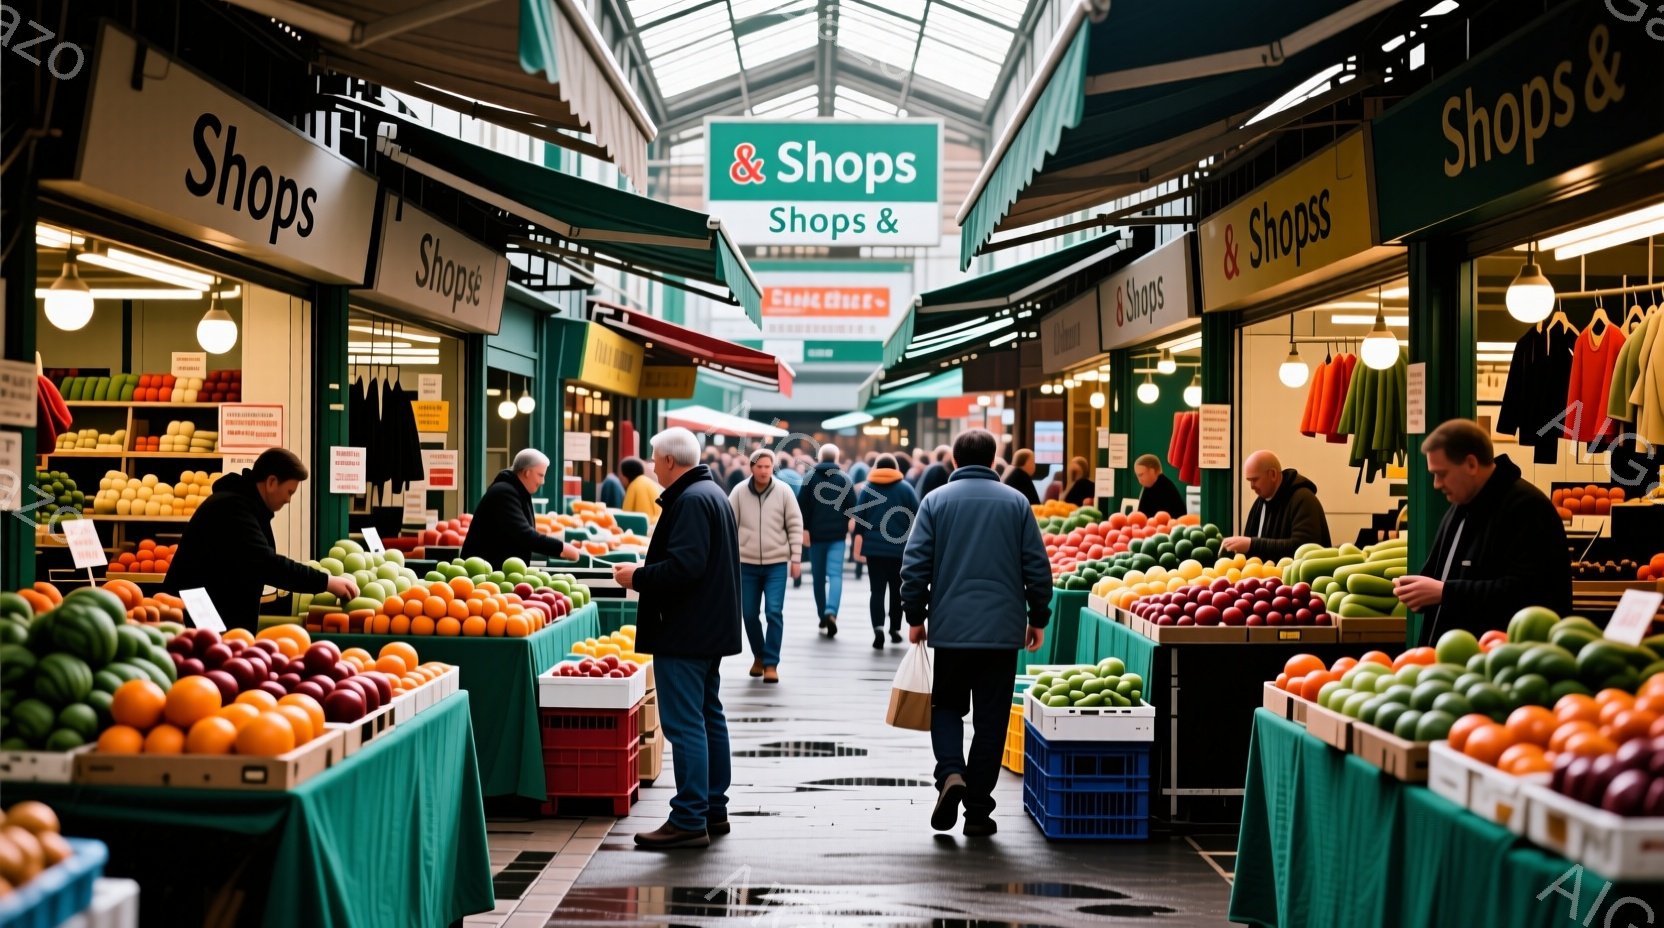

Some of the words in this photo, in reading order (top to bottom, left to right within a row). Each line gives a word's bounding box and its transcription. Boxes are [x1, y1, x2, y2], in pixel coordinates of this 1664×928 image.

[1442, 60, 1575, 177] Shops
[1584, 24, 1625, 113] &
[185, 113, 317, 245] Shops
[730, 143, 766, 185] &
[777, 140, 917, 194] Shops
[769, 206, 866, 240] Shops
[876, 207, 899, 234] &
[1224, 224, 1240, 280] &
[1249, 188, 1331, 269] Shopss
[1126, 275, 1164, 324] Shops
